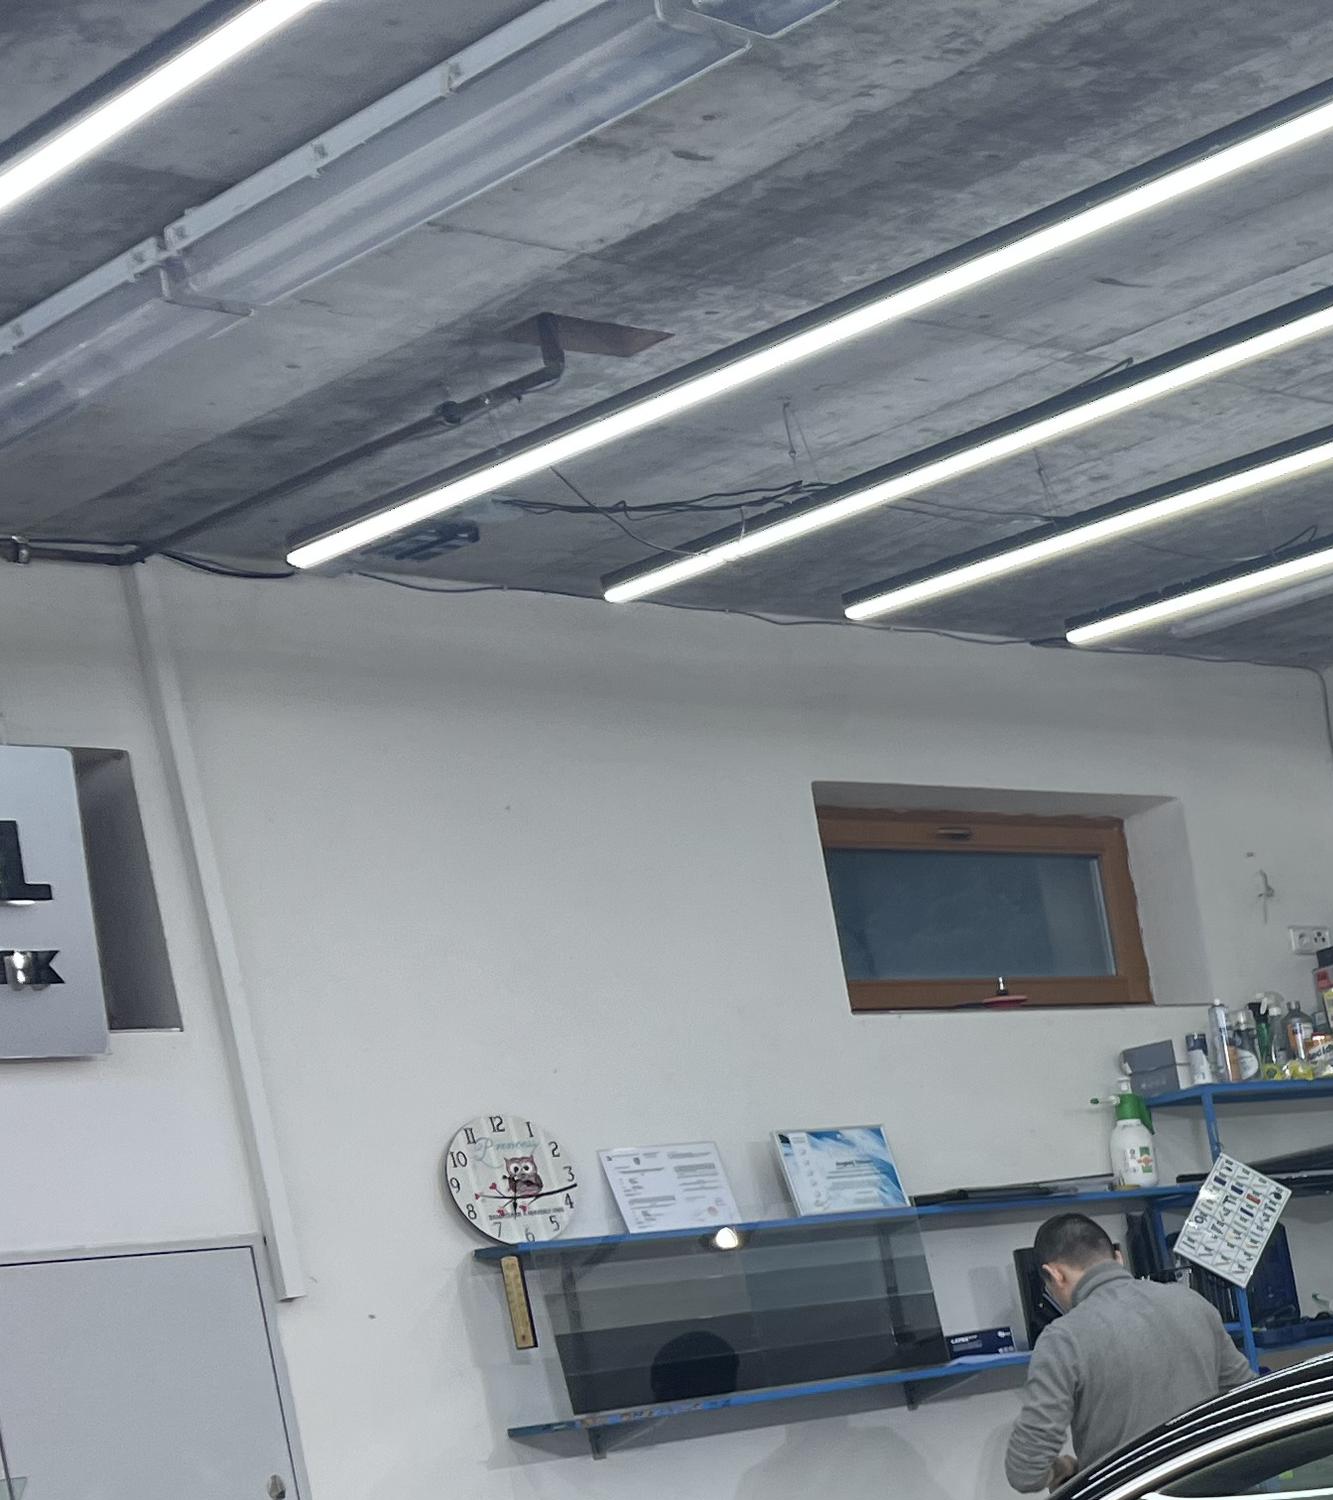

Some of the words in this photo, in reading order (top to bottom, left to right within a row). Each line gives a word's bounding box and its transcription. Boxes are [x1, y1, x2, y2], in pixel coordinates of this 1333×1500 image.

[489, 1116, 505, 1132] 12
[548, 1141, 560, 1158] 2
[450, 1151, 468, 1168] 10
[563, 1166, 575, 1182] 3
[450, 1177, 461, 1193] 9
[564, 1193, 574, 1209] 4
[466, 1203, 477, 1220] 8
[493, 1222, 502, 1238] 7
[549, 1215, 560, 1232] 5
[525, 1227, 535, 1242] 6
